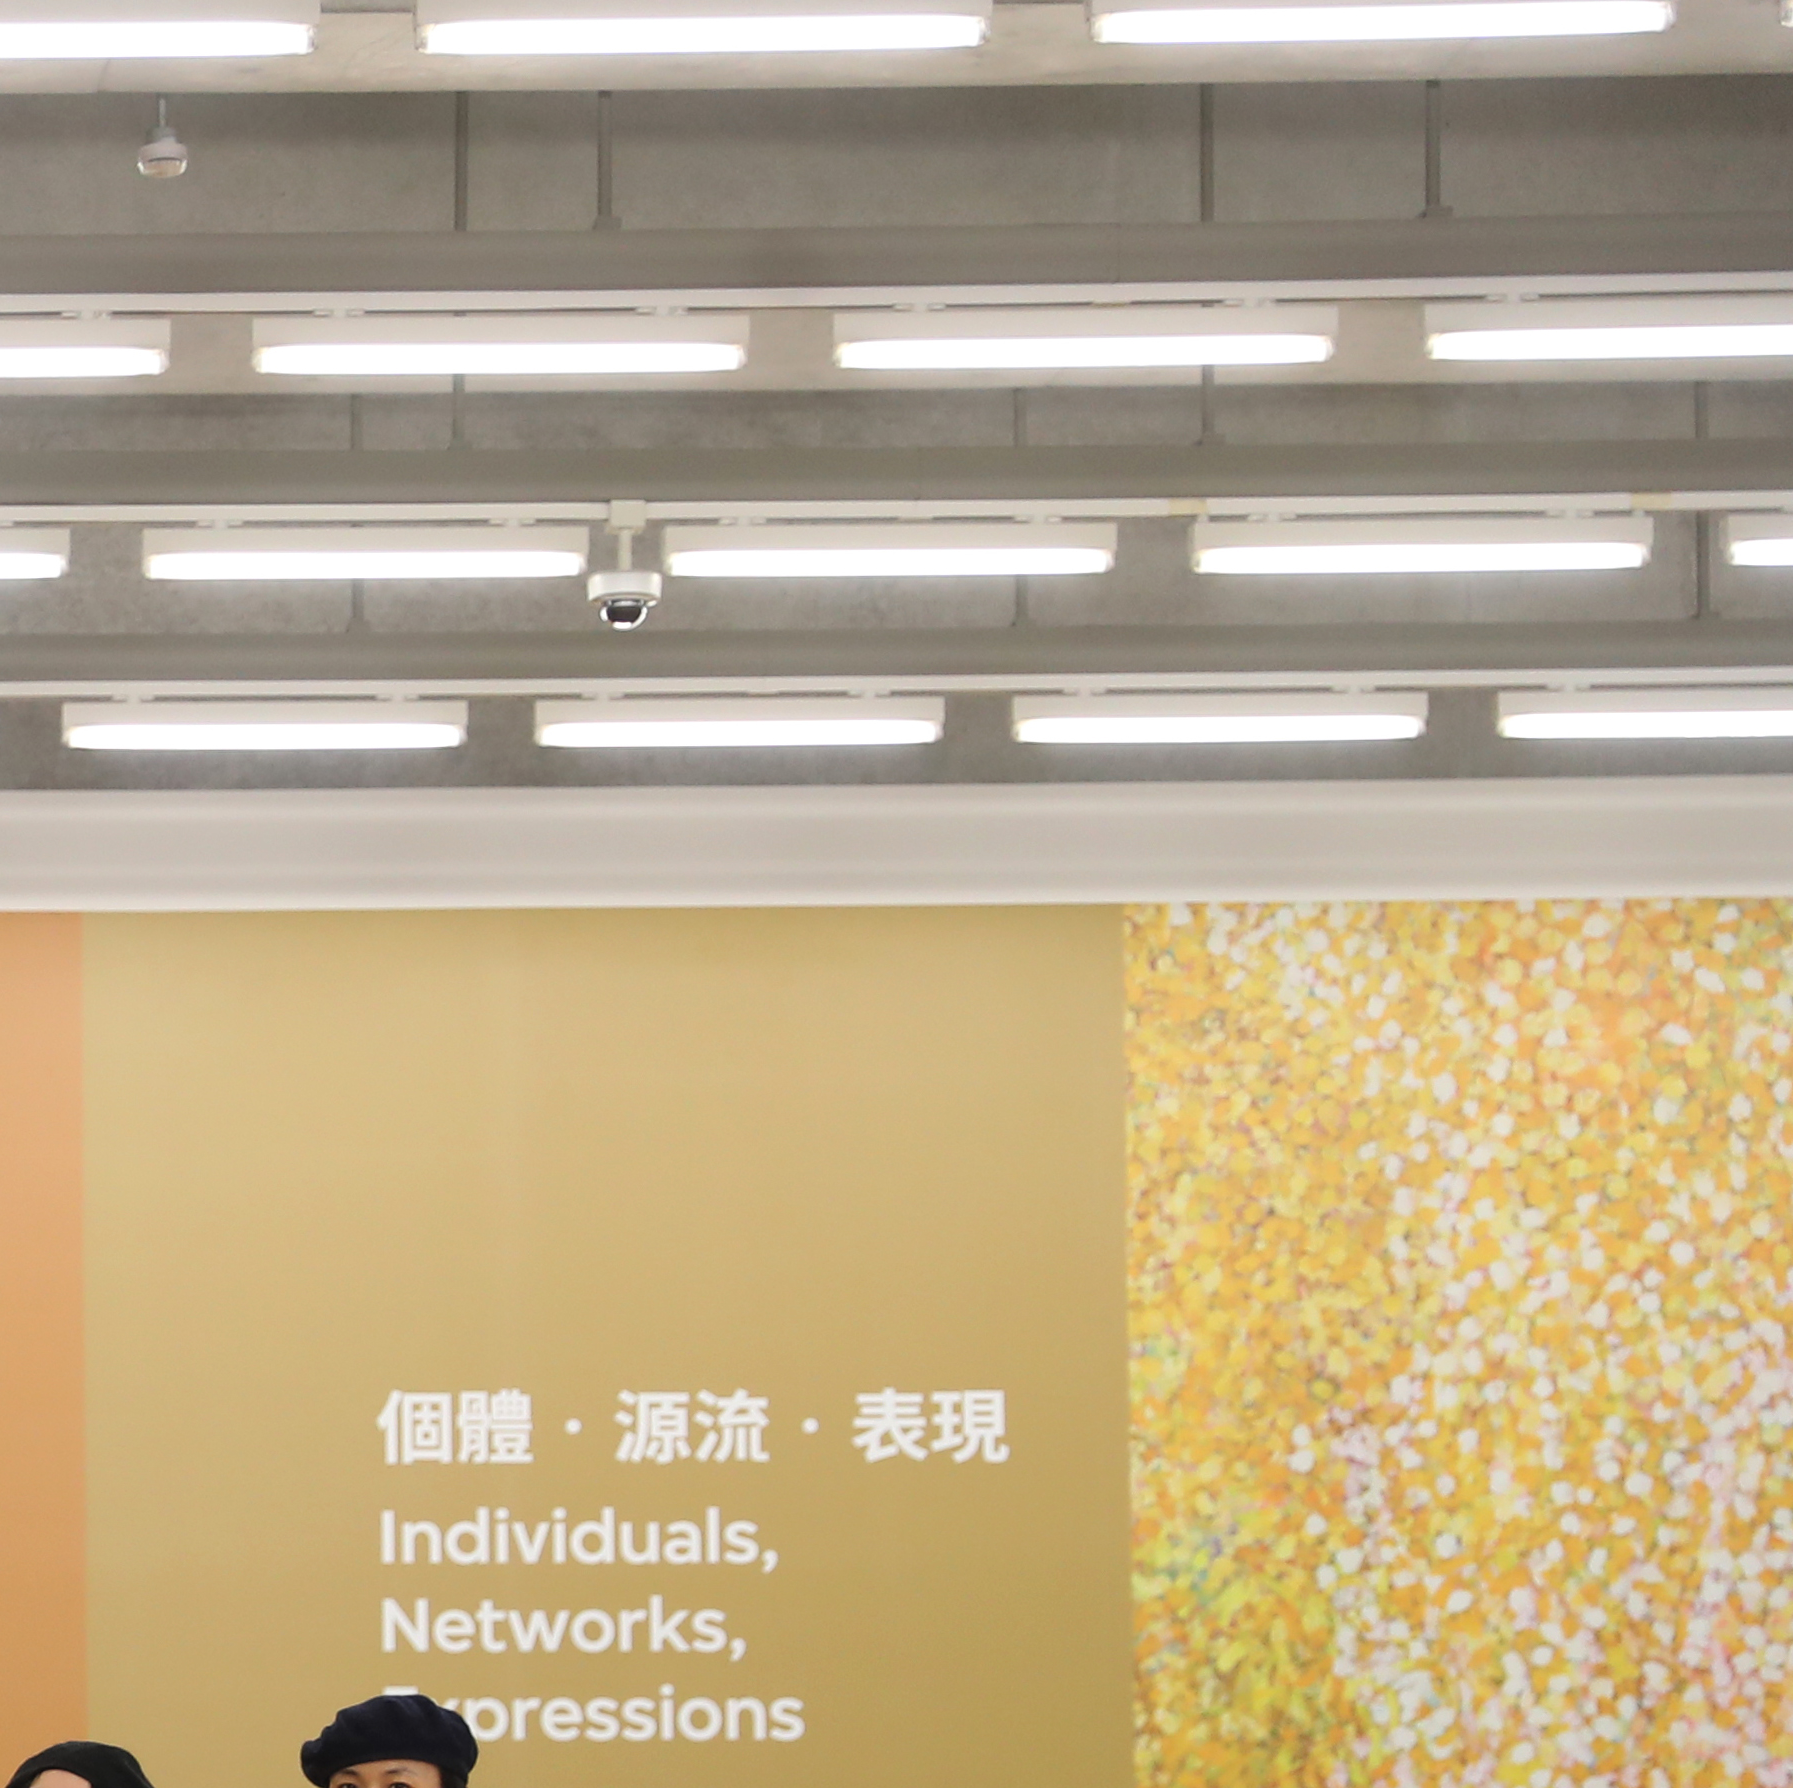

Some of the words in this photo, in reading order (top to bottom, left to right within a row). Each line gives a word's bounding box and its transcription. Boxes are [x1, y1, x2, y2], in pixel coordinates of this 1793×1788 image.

[379, 1505, 780, 1574] Individuals,
[380, 1593, 749, 1662] Networks,
[381, 1684, 806, 1742] pressions
